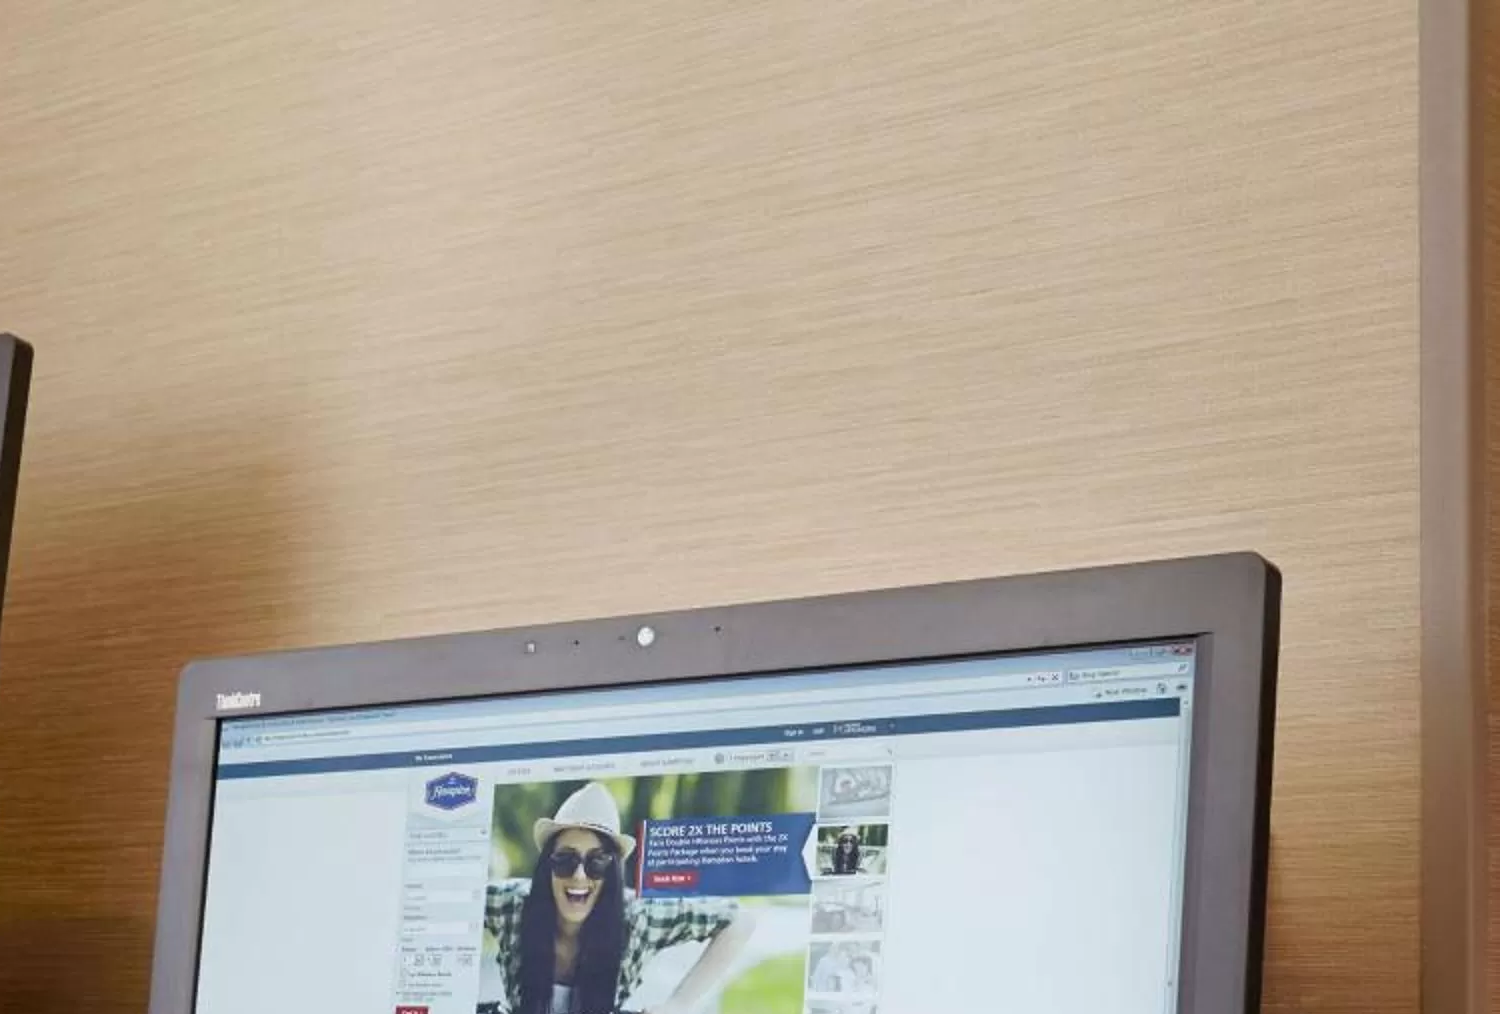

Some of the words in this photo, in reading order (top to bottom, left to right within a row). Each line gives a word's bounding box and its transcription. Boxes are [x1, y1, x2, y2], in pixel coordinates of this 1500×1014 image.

[650, 825, 686, 837] SCORE
[687, 825, 703, 836] 2X
[706, 823, 728, 836] THE
[731, 821, 773, 834] POINTS
